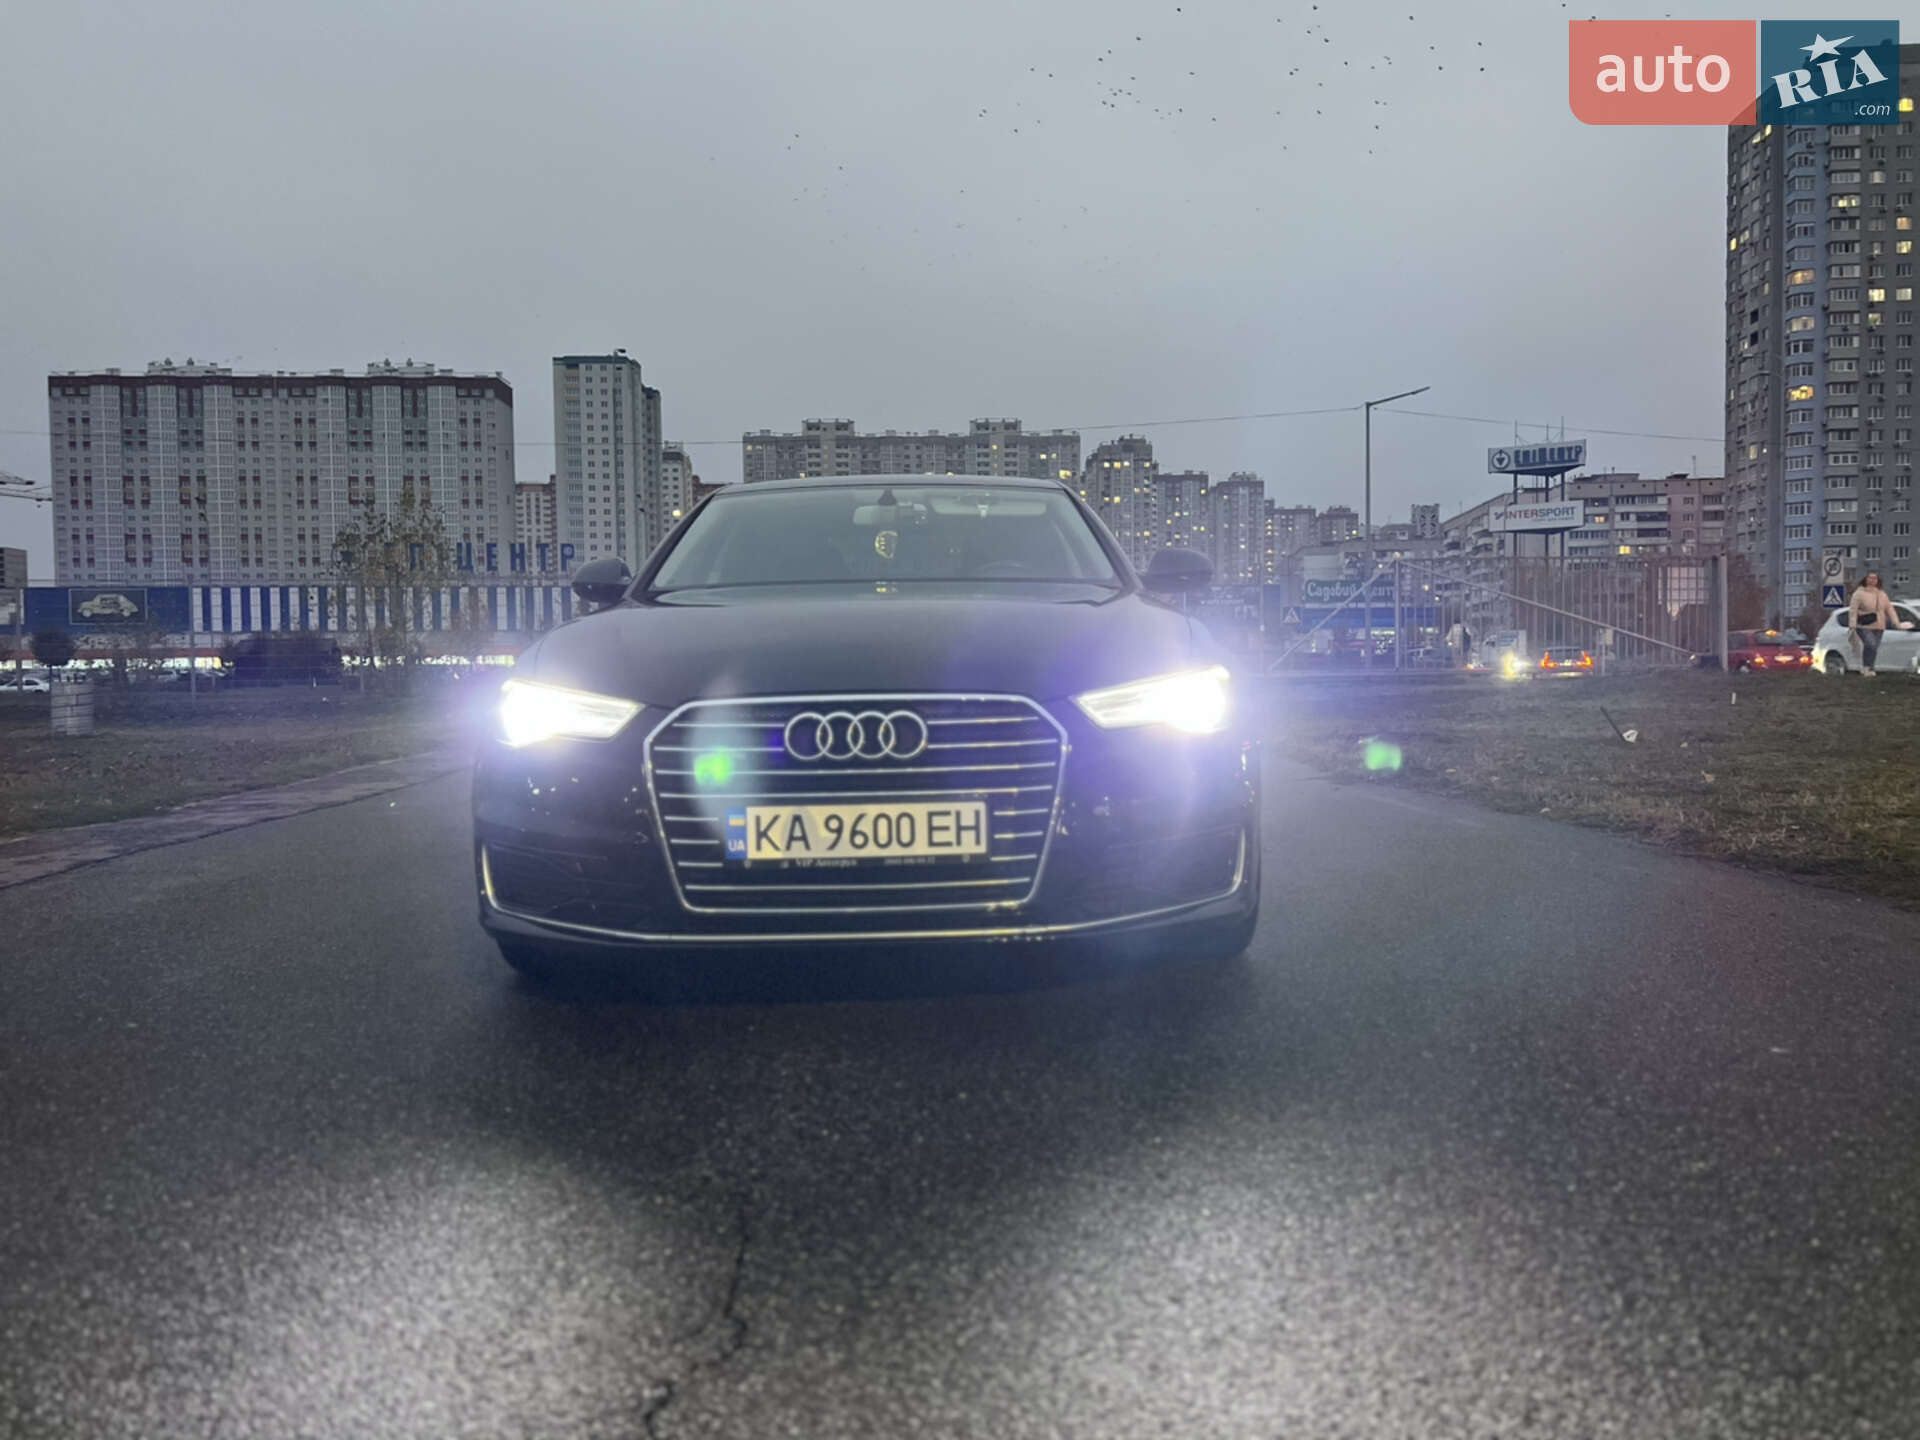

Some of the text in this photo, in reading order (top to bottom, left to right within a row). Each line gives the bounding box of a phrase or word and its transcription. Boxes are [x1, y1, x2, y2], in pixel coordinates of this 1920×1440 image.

[1505, 507, 1576, 519] INTERSPORT
[755, 810, 981, 851] KA 9600 EH
[728, 840, 745, 852] UA
